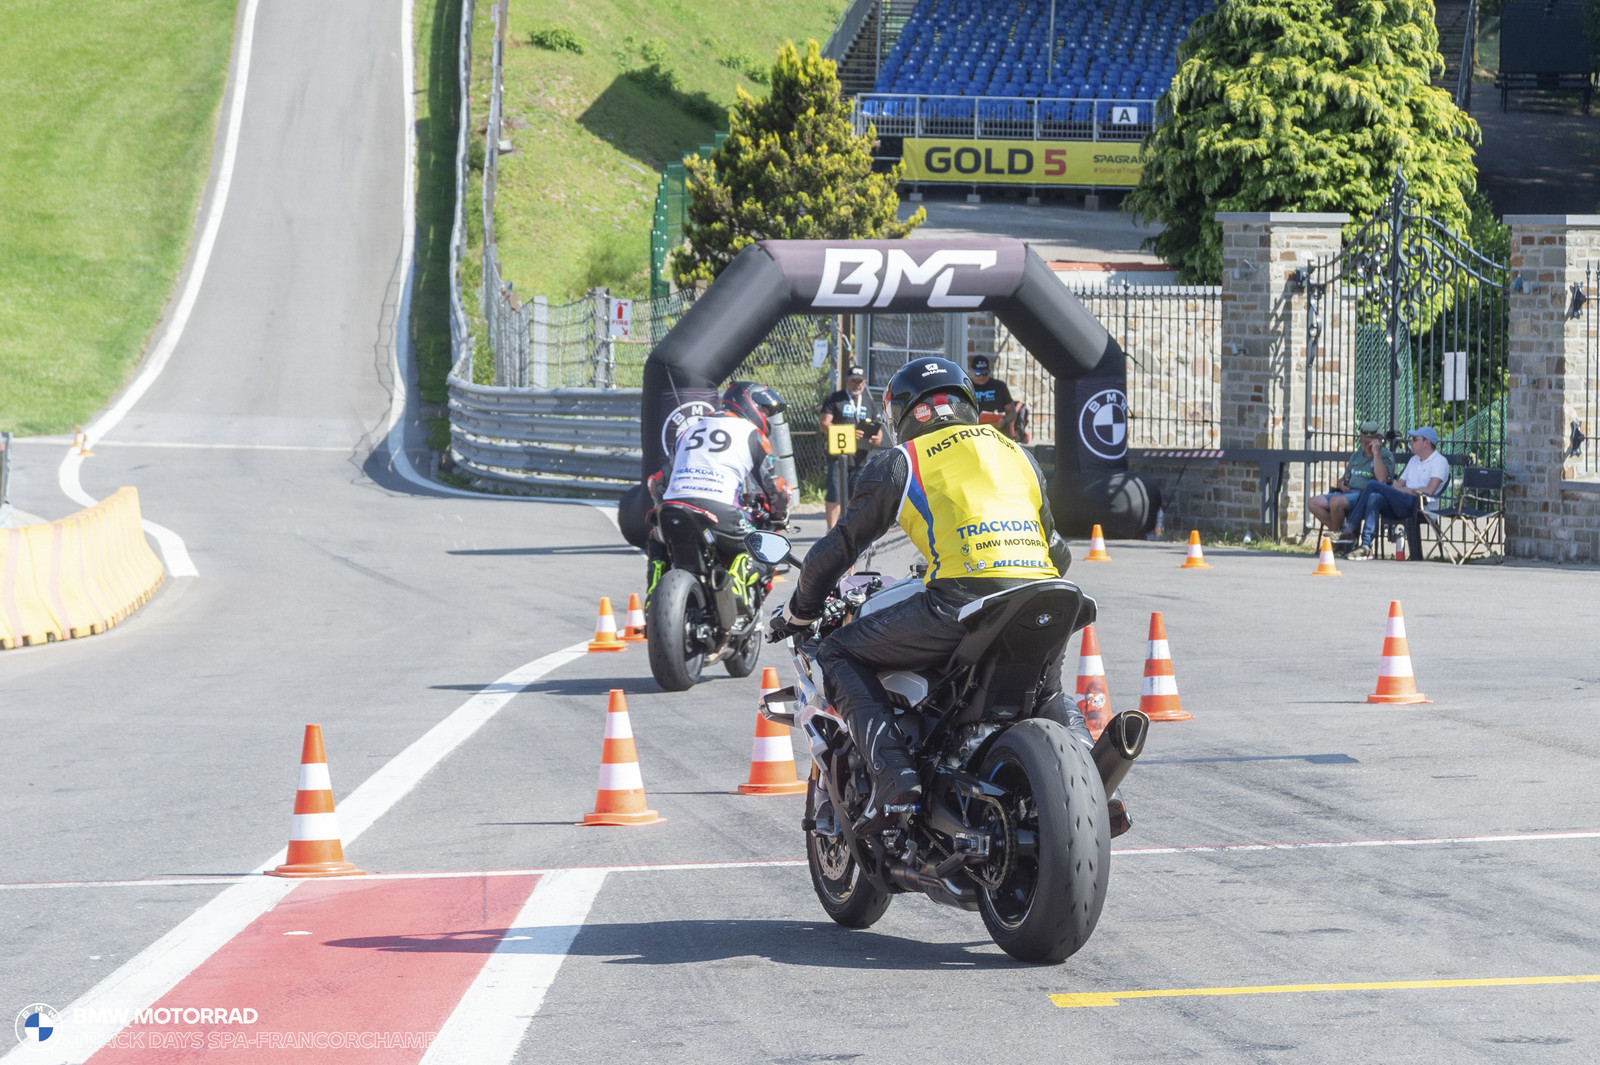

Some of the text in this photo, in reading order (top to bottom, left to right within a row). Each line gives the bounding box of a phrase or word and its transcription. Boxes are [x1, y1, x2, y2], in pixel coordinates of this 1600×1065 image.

[1118, 108, 1131, 122] A
[924, 146, 1067, 176] GOLD 5
[810, 247, 997, 308] BMC
[921, 368, 948, 378] SHARK
[975, 390, 996, 399] MC
[1088, 392, 1128, 414] BMW
[671, 405, 704, 426] BM
[685, 427, 732, 453] 59
[837, 433, 847, 449] B
[926, 427, 1017, 458] INSTRUCTEUR
[975, 539, 1001, 551] BMW
[1004, 538, 1048, 550] MOTORRA
[993, 559, 1049, 568] MICHEL
